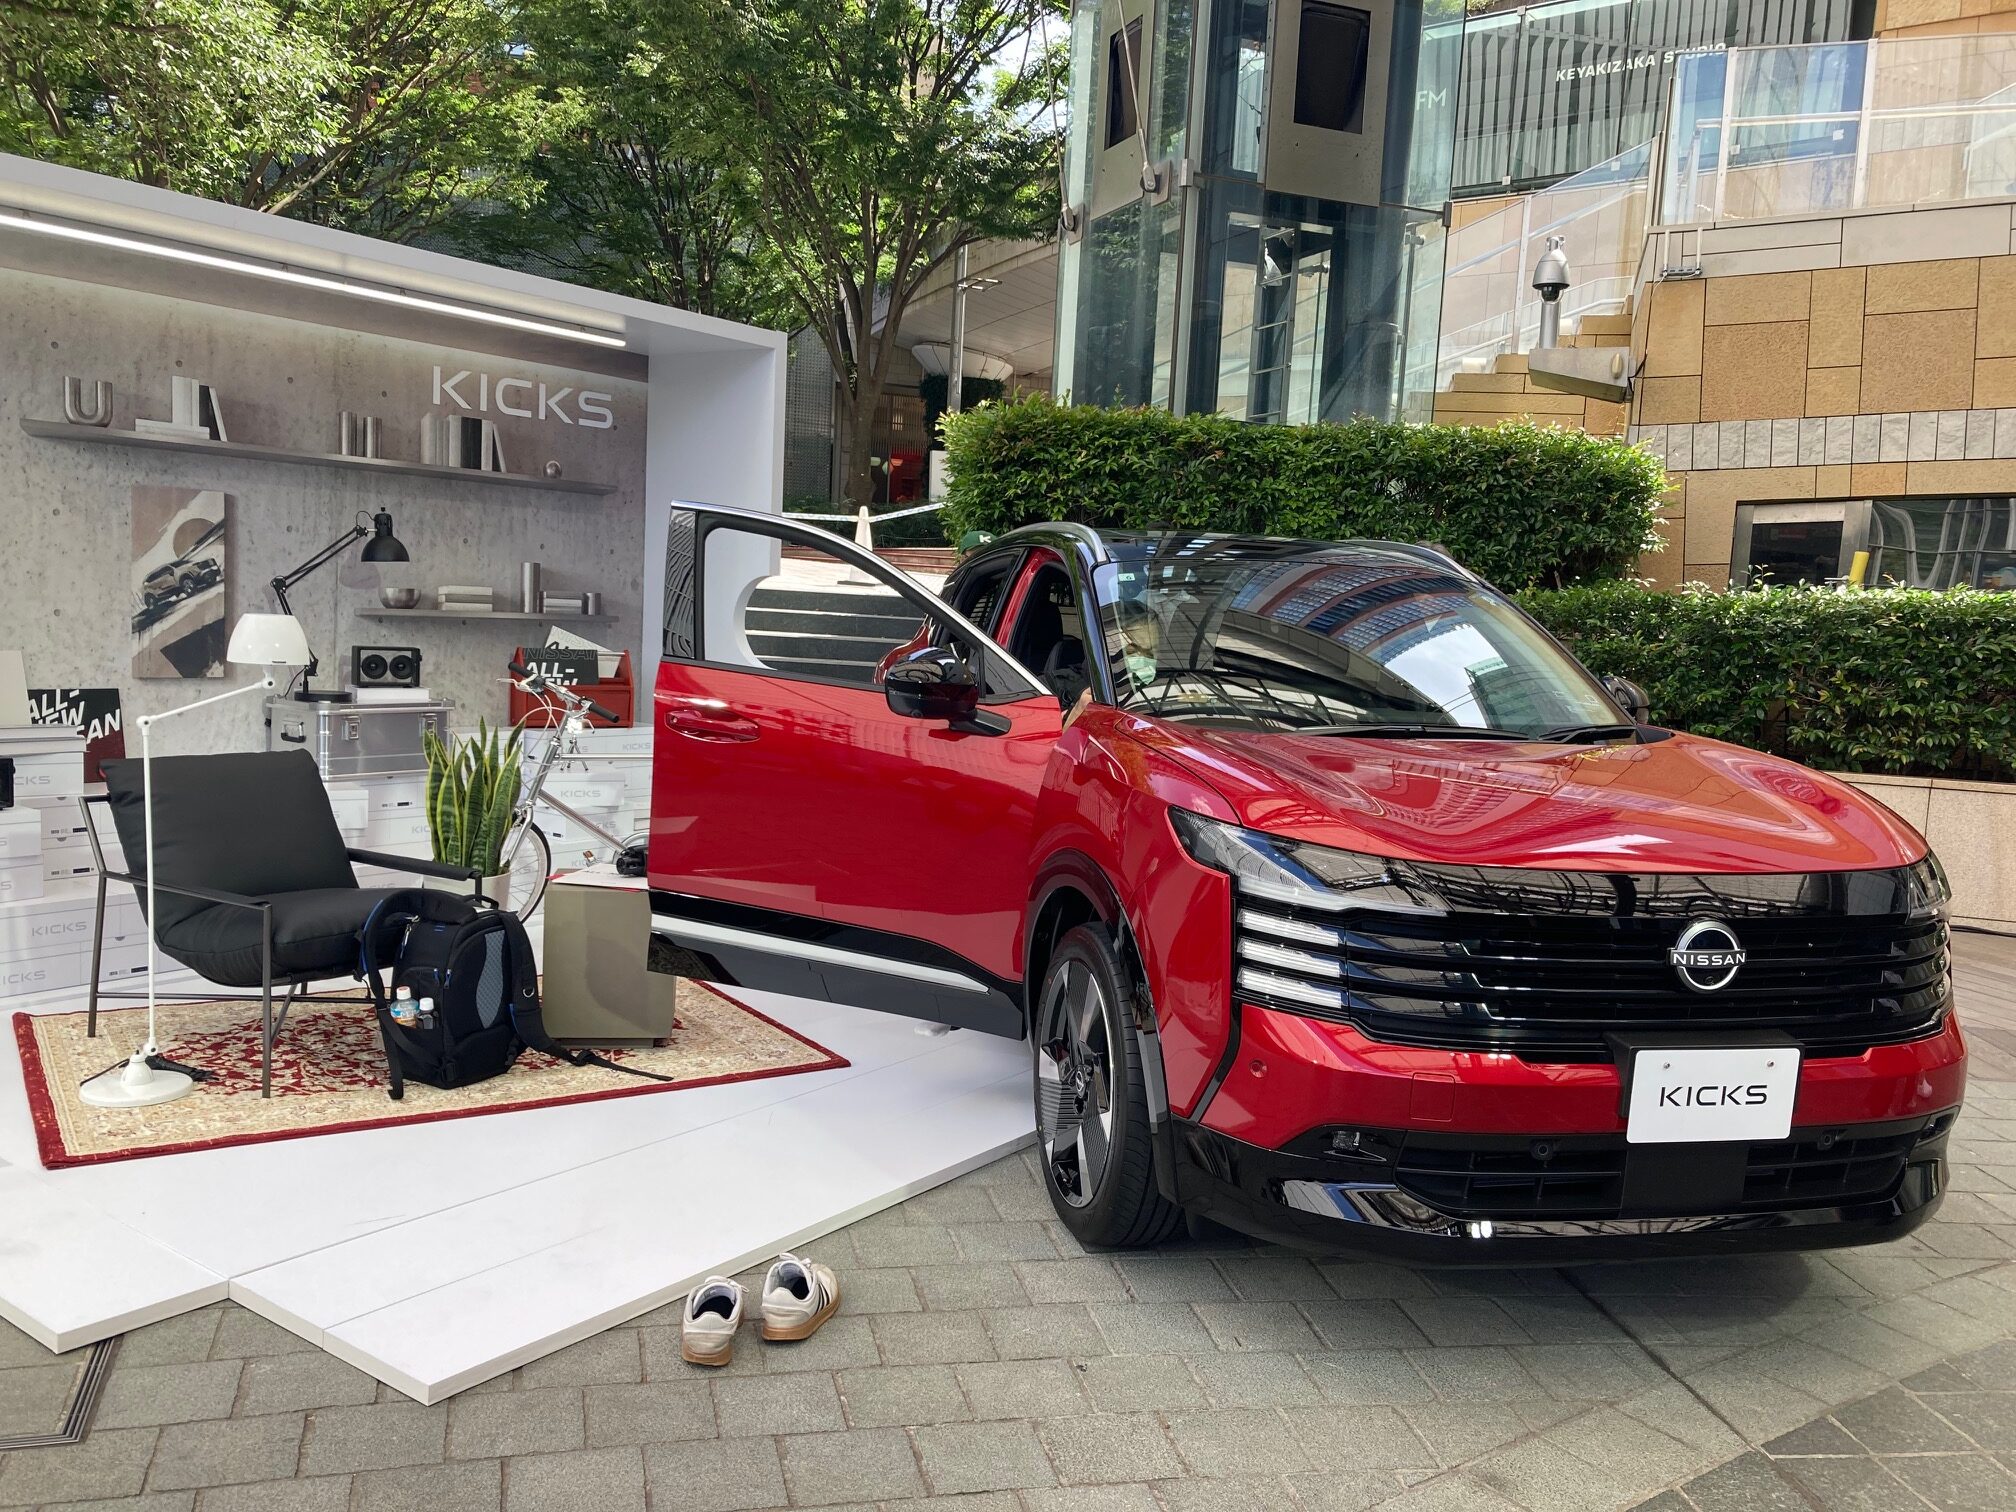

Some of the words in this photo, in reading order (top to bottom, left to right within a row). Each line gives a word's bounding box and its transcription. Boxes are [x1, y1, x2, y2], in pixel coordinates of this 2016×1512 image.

[1556, 54, 1656, 81] KEYAKIZAKA
[1416, 88, 1447, 111] FM
[432, 365, 614, 429] KICKS
[979, 535, 992, 543] K
[38, 701, 85, 726] EW
[622, 742, 652, 751] KICKS
[14, 776, 51, 785] CKS
[560, 790, 601, 798] KICKS
[411, 825, 430, 834] KIC
[32, 921, 88, 936] KICKS
[1673, 952, 1746, 967] NISSAN
[2, 969, 47, 985] ICKS
[1659, 1085, 1768, 1107] KICKS
